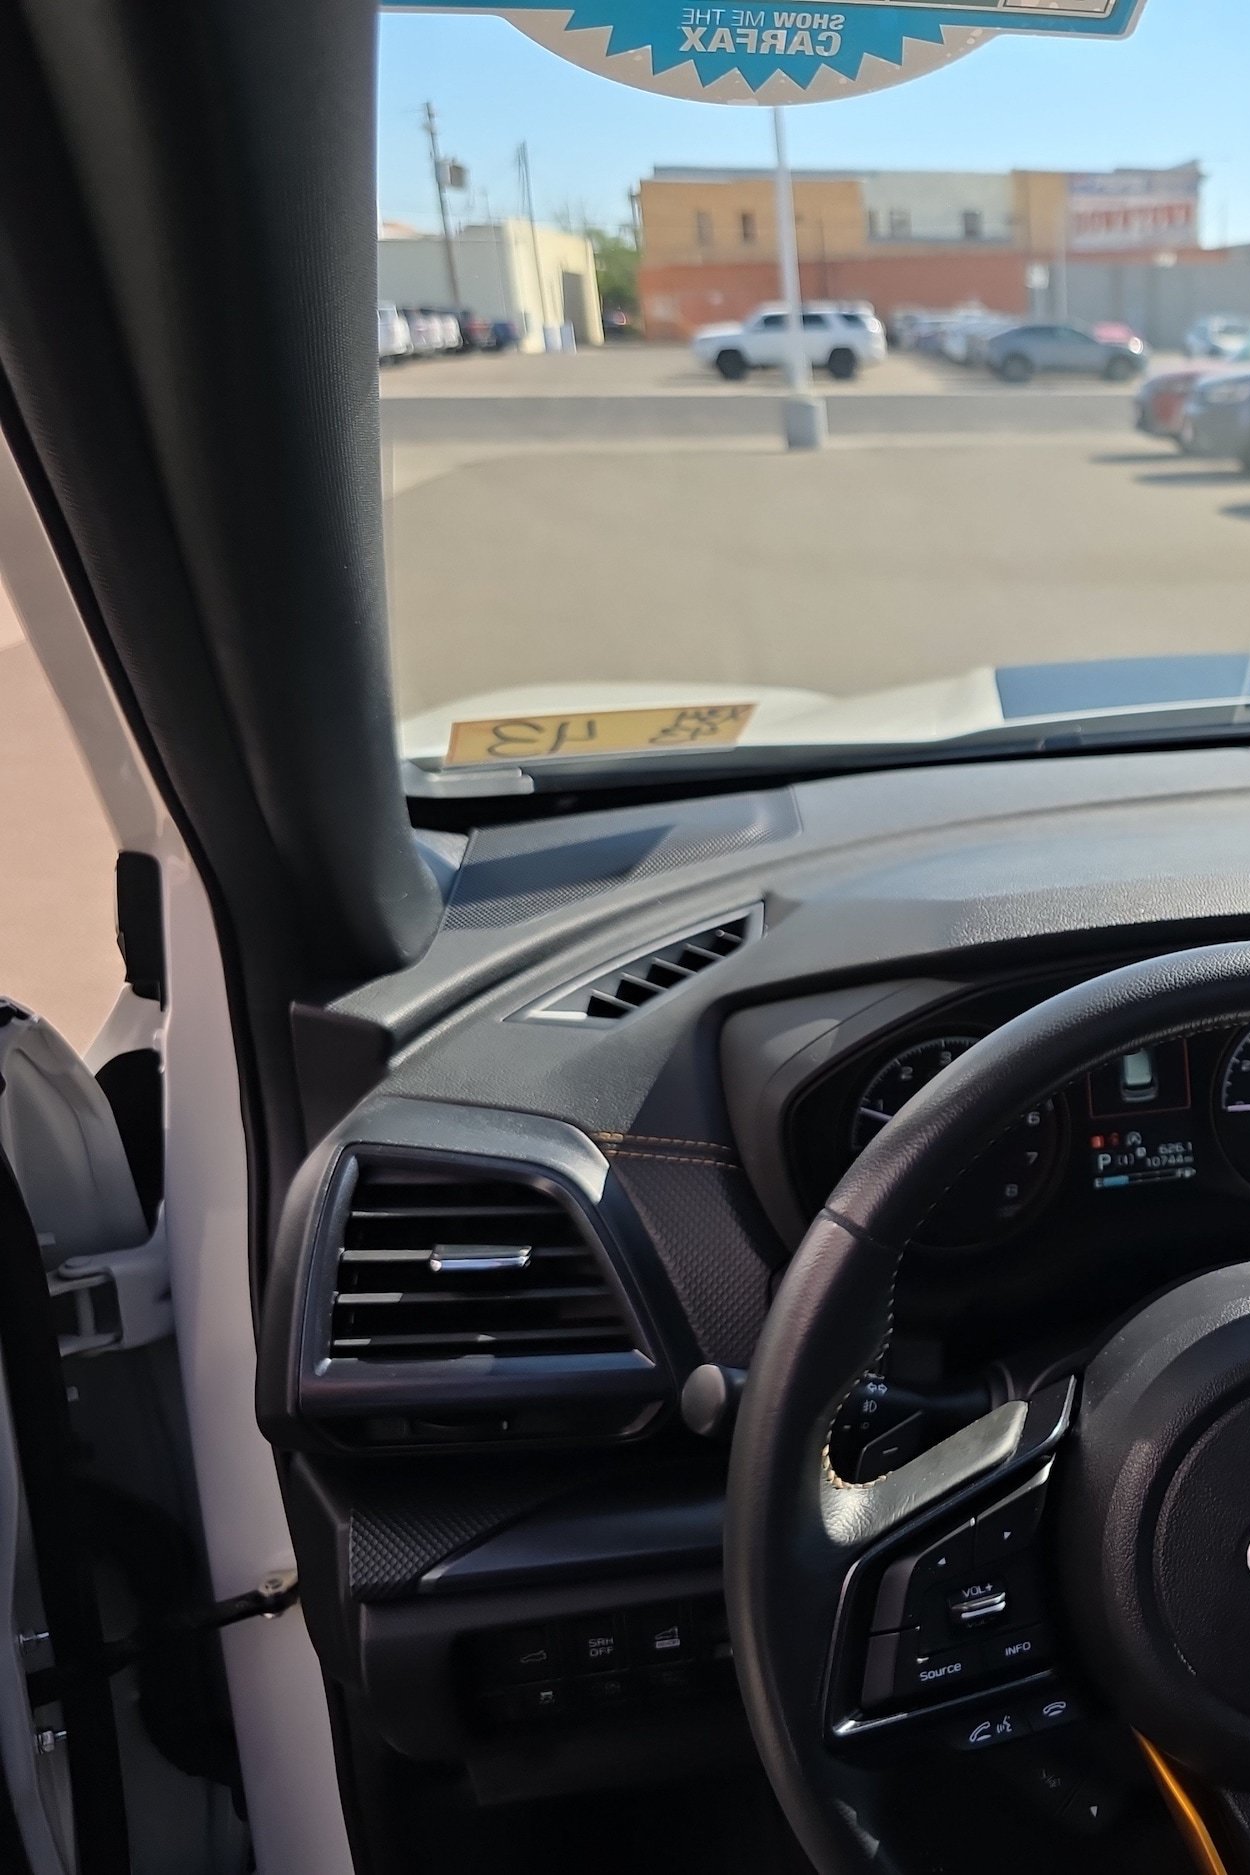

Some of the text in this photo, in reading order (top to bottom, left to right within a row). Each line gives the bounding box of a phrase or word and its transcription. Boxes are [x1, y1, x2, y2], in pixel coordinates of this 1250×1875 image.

[900, 1066, 914, 1081] 2
[1026, 1111, 1041, 1126] 6
[1025, 1151, 1040, 1165] 7
[1098, 1153, 1112, 1171] P
[1005, 1183, 1019, 1198] 8
[589, 1647, 614, 1658] OFF
[1004, 1640, 1032, 1657] INFO
[919, 1661, 963, 1682] Source
